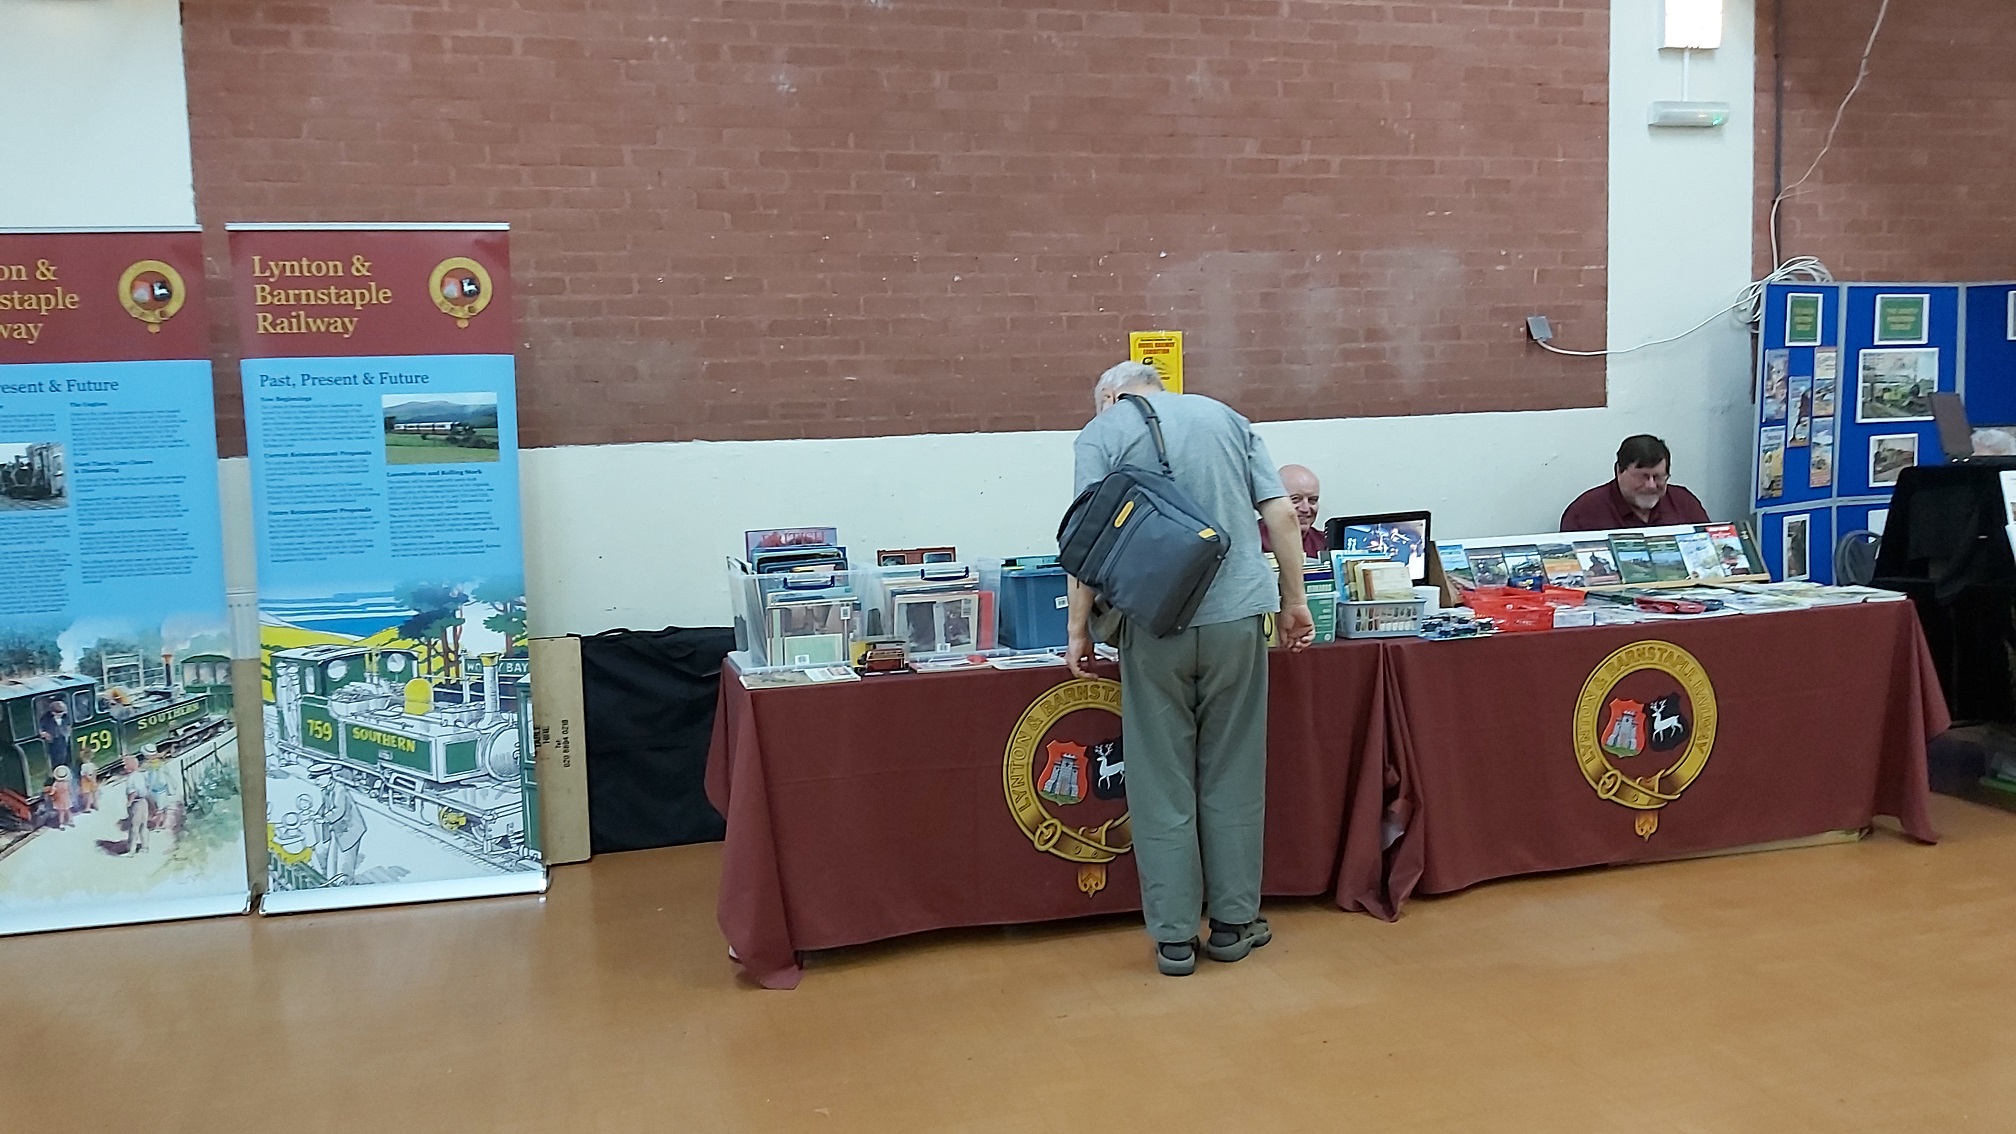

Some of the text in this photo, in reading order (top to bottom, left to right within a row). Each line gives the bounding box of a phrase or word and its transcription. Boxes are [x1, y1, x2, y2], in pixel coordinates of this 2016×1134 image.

[35, 258, 58, 281] &
[251, 254, 373, 282] Lynton &
[0, 286, 80, 315] staple
[254, 281, 393, 310] Barnstaple
[0, 323, 44, 344] way
[256, 310, 359, 338] Railway
[0, 378, 120, 394] esent & Future
[259, 371, 430, 389] Past, Present & Future
[506, 662, 529, 673] BAY
[137, 701, 200, 731] SOUTHERN
[76, 729, 113, 753] 759
[306, 719, 333, 742] 759
[352, 726, 417, 753] SOUTHERN
[1009, 685, 1122, 813] LYNTON & BARNSTA
